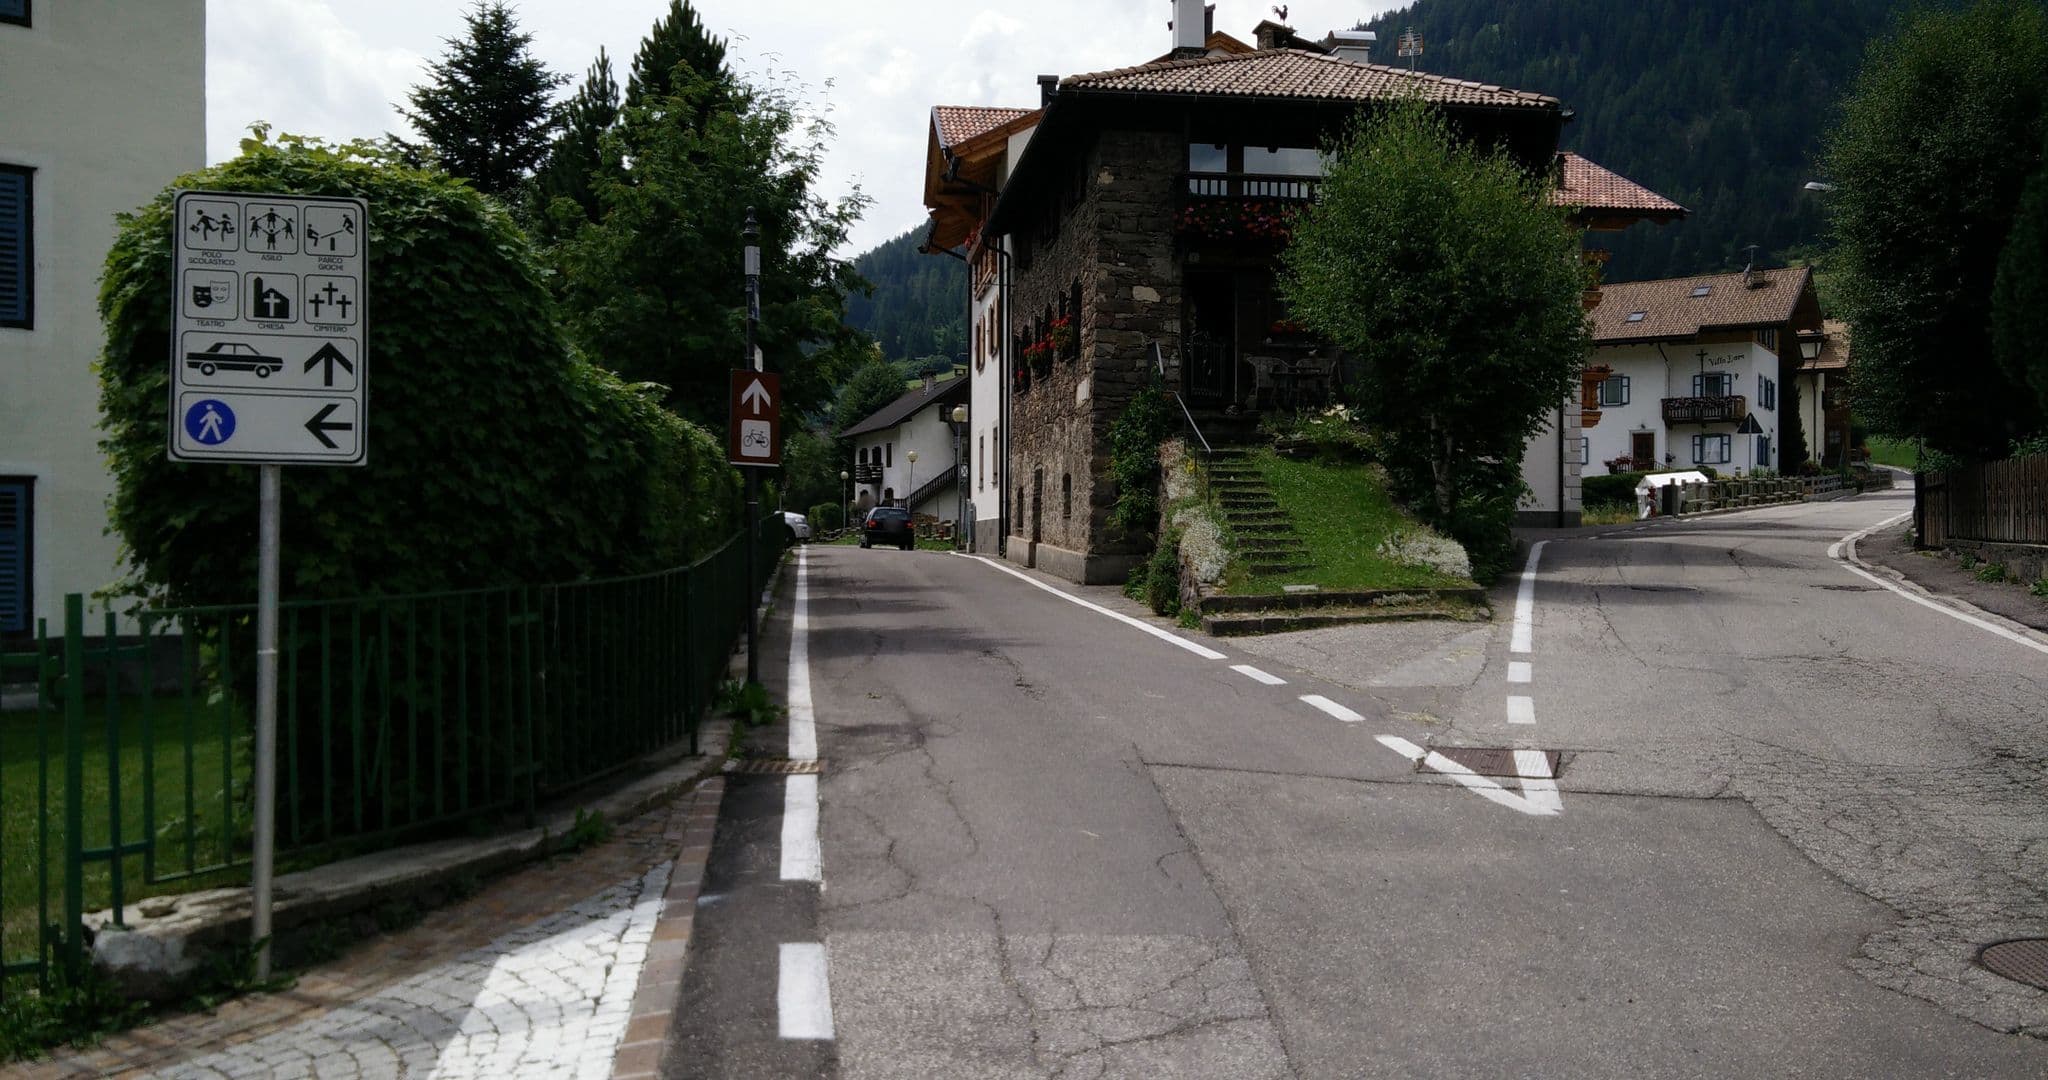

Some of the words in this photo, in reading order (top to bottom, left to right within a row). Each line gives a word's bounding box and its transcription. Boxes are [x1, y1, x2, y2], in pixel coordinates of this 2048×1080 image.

[202, 250, 222, 258] POLO
[188, 256, 236, 266] SCOLASTICO
[196, 320, 226, 328] TEATRO
[314, 324, 348, 333] CIMITERO
